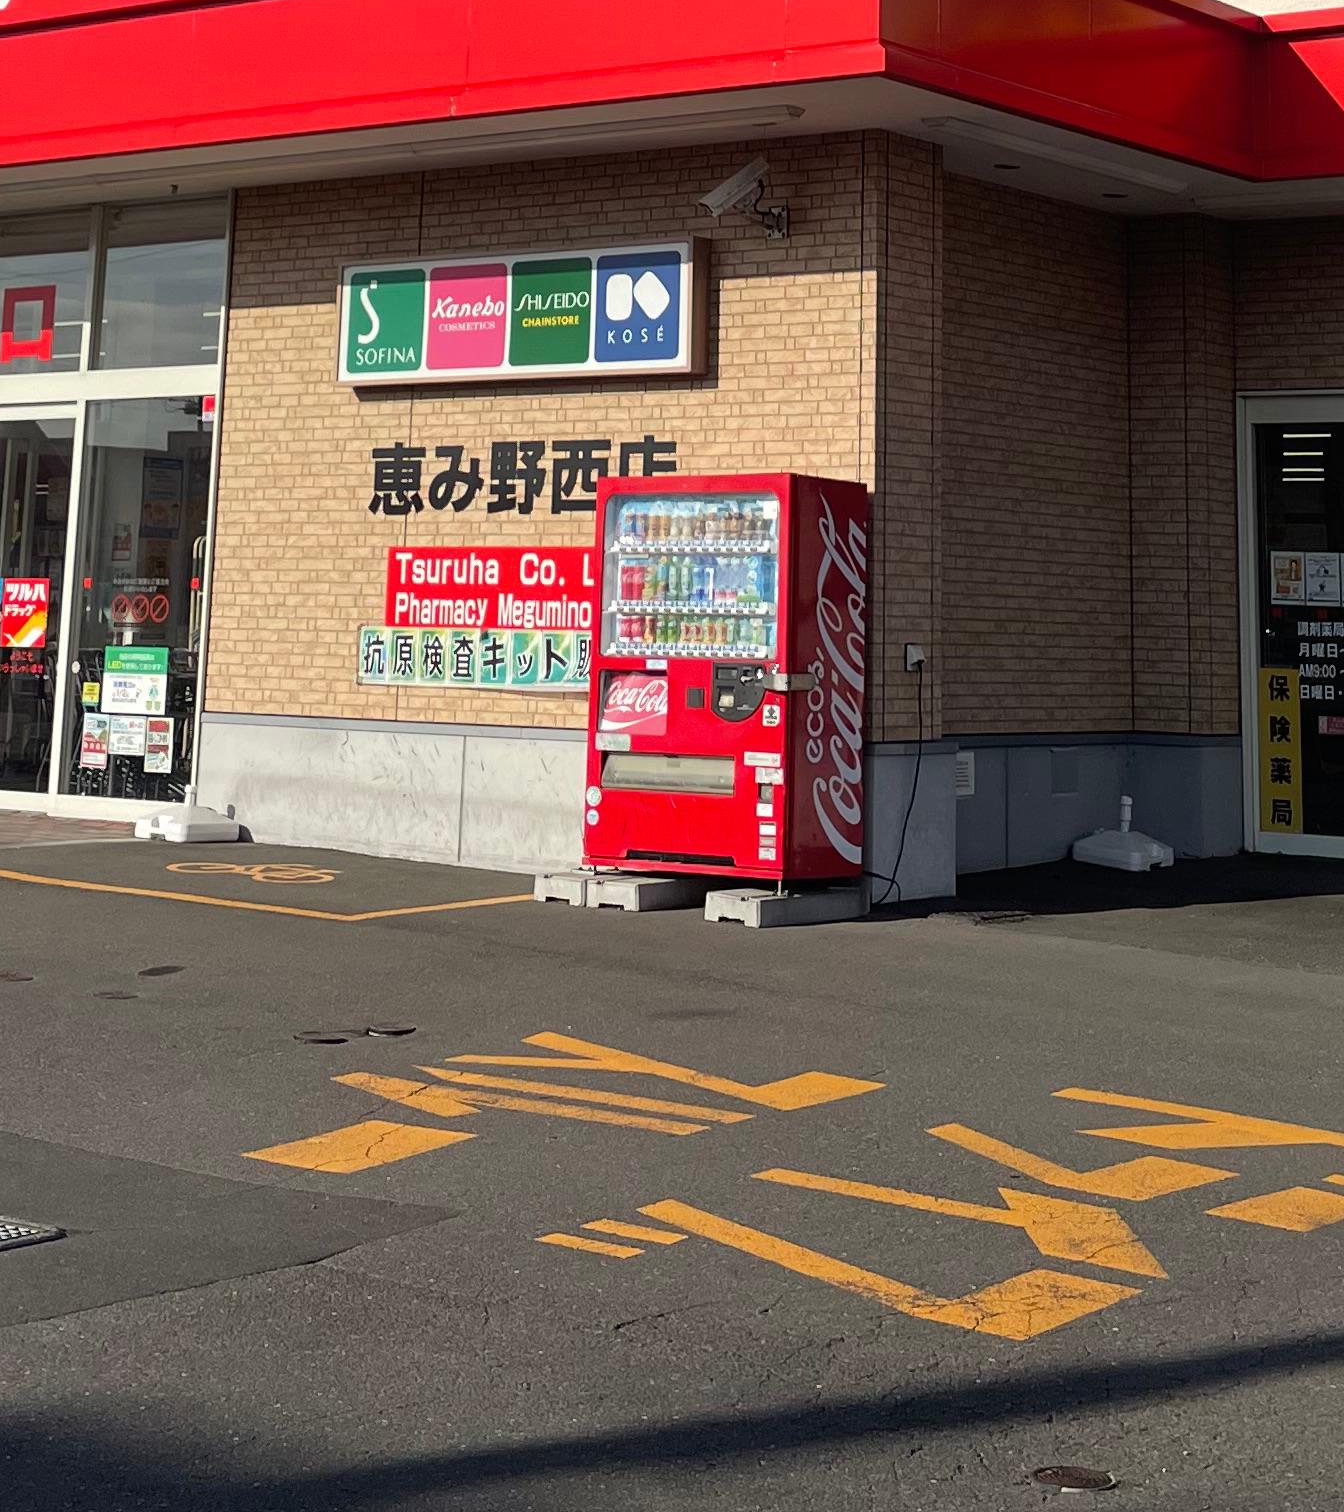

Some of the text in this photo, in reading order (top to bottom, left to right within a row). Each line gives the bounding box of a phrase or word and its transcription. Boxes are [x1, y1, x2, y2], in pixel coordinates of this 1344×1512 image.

[431, 296, 506, 320] Kanebo
[514, 291, 590, 312] SHISEIDO
[438, 321, 496, 333] COSMETICS
[522, 315, 580, 328] CHAINSTORE
[607, 325, 665, 345] KOSÉ
[355, 347, 416, 366] SOFINA
[395, 552, 499, 586] Tsuruha
[519, 553, 565, 587] Co.
[5, 583, 47, 602] ツルハ
[3, 603, 36, 617] ドラッグ
[394, 592, 592, 629] Pharmacy Megumino
[1298, 663, 1337, 679] AM9:00
[1267, 674, 1294, 826] 保険薬局
